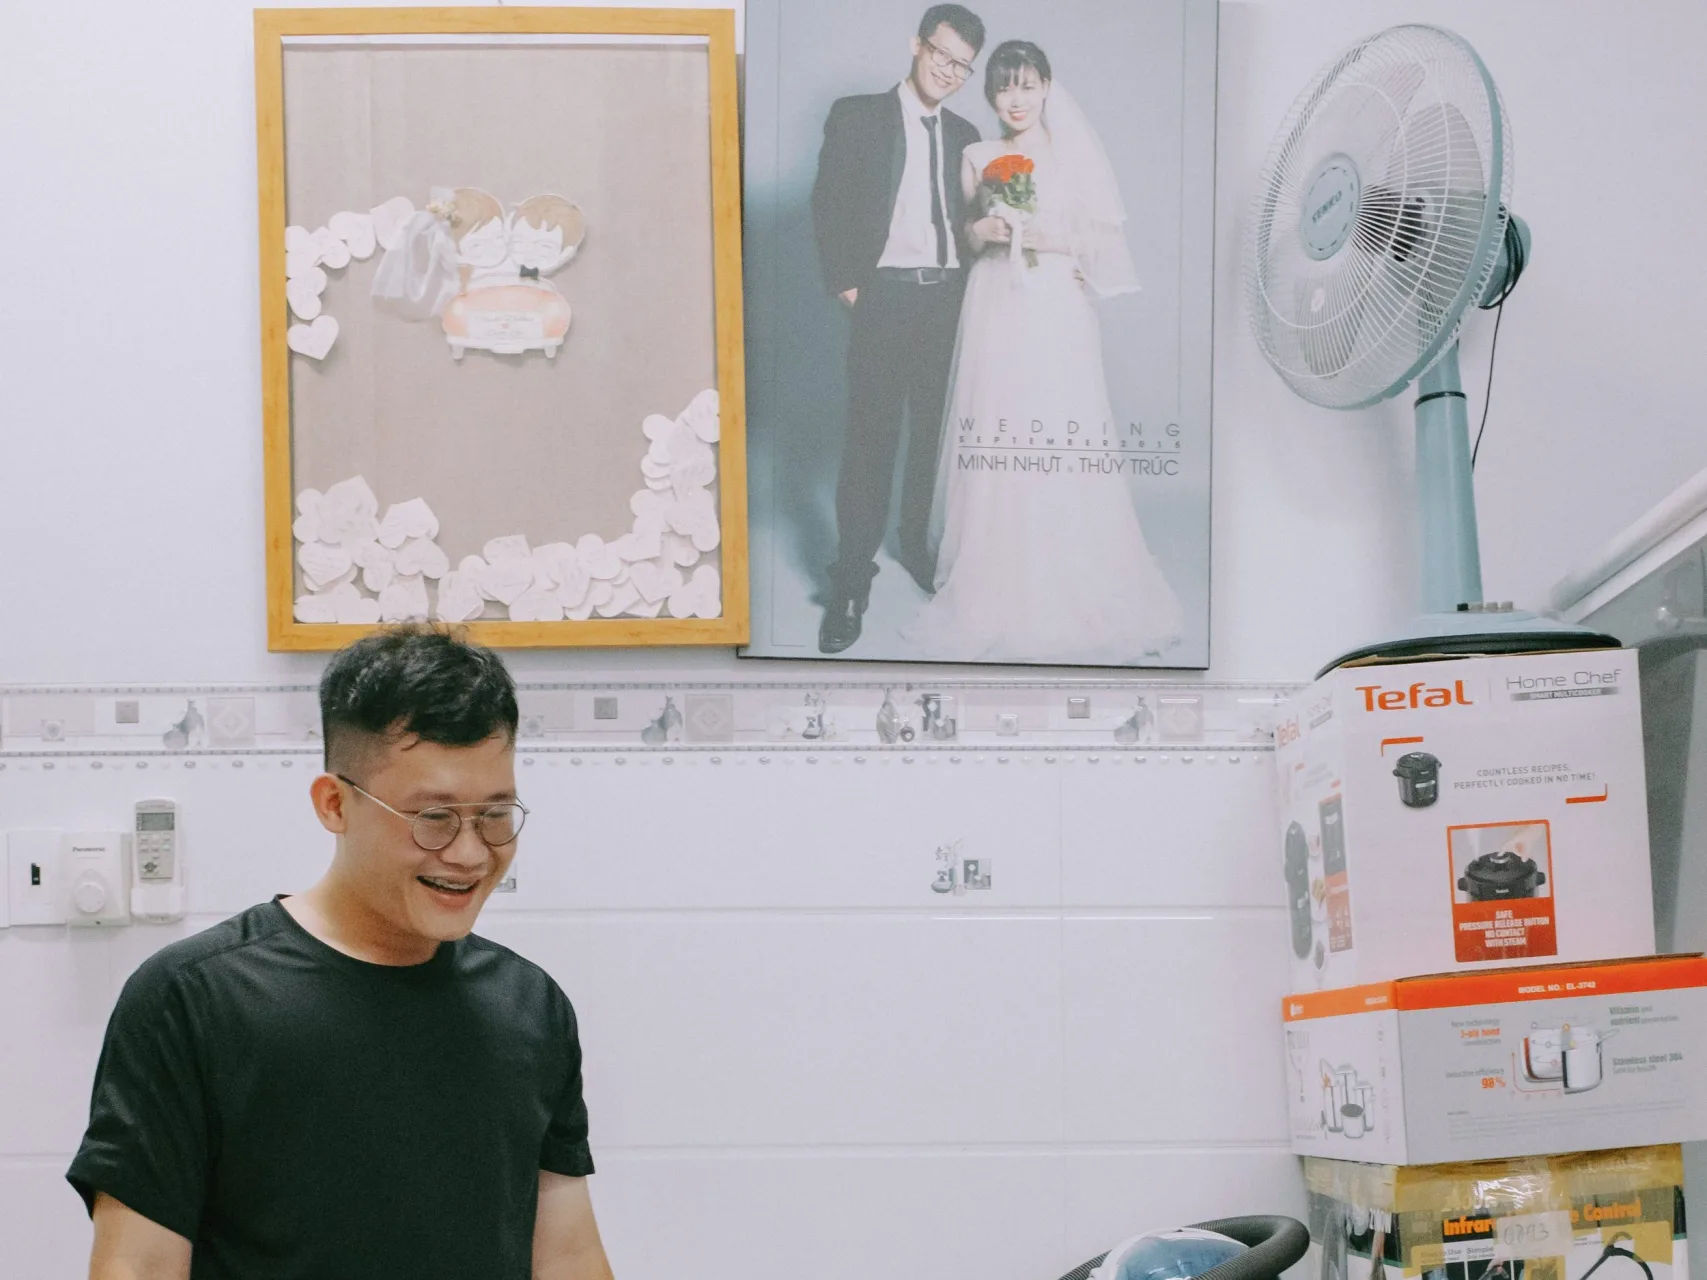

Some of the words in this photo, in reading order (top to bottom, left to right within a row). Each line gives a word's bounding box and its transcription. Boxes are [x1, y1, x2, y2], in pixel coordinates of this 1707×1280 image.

[958, 418, 1180, 437] WEDDING
[958, 454, 1007, 471] MINH
[1130, 456, 1179, 475] TRÚC
[1506, 675, 1567, 690] Home
[1573, 669, 1622, 685] Chef
[1355, 680, 1473, 712] Tefal
[1477, 766, 1529, 777] COUNTLESS
[1453, 780, 1503, 789] PERFECTLY
[1507, 777, 1541, 786] COOKED
[1545, 775, 1553, 783] IN
[1556, 774, 1569, 782] NO
[1495, 910, 1513, 919] SAFE
[1459, 921, 1493, 931] PRESSURE
[1494, 919, 1523, 928] RELEASE
[1523, 916, 1549, 926] BUTTON
[1496, 927, 1525, 938] CONTACT
[1503, 937, 1527, 946] STEAM
[1518, 985, 1546, 994] MODEL
[1443, 1215, 1496, 1236] Infrar
